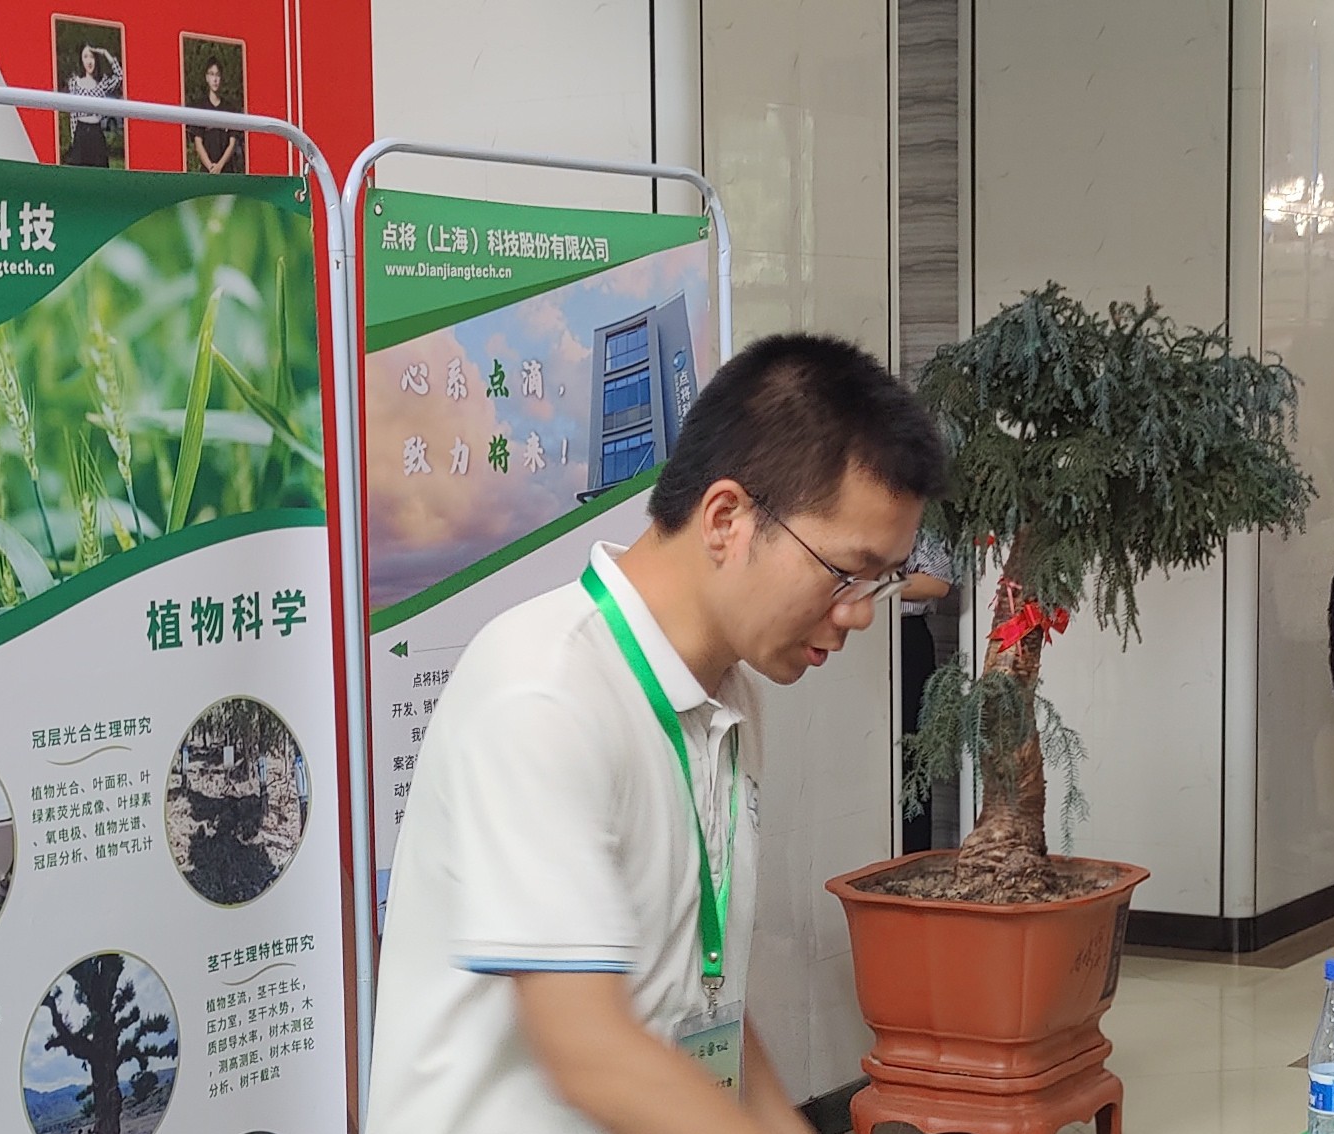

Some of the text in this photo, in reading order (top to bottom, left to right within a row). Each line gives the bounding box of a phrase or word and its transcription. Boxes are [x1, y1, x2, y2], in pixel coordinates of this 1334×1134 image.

[381, 221, 610, 263] 点将（上海）科技股份有限公司
[385, 262, 513, 281] www.Dianjiangtech.cn
[146, 588, 308, 652] 植物科学
[412, 669, 454, 689] 点将科技
[31, 716, 153, 750] 冠层光合生理研究
[393, 753, 418, 772] 案咨
[31, 770, 151, 801] 植物光合、叶面积、叶
[33, 836, 154, 871] 冠层分析、植物气孔计
[207, 934, 315, 974] 茎干生理特性研究
